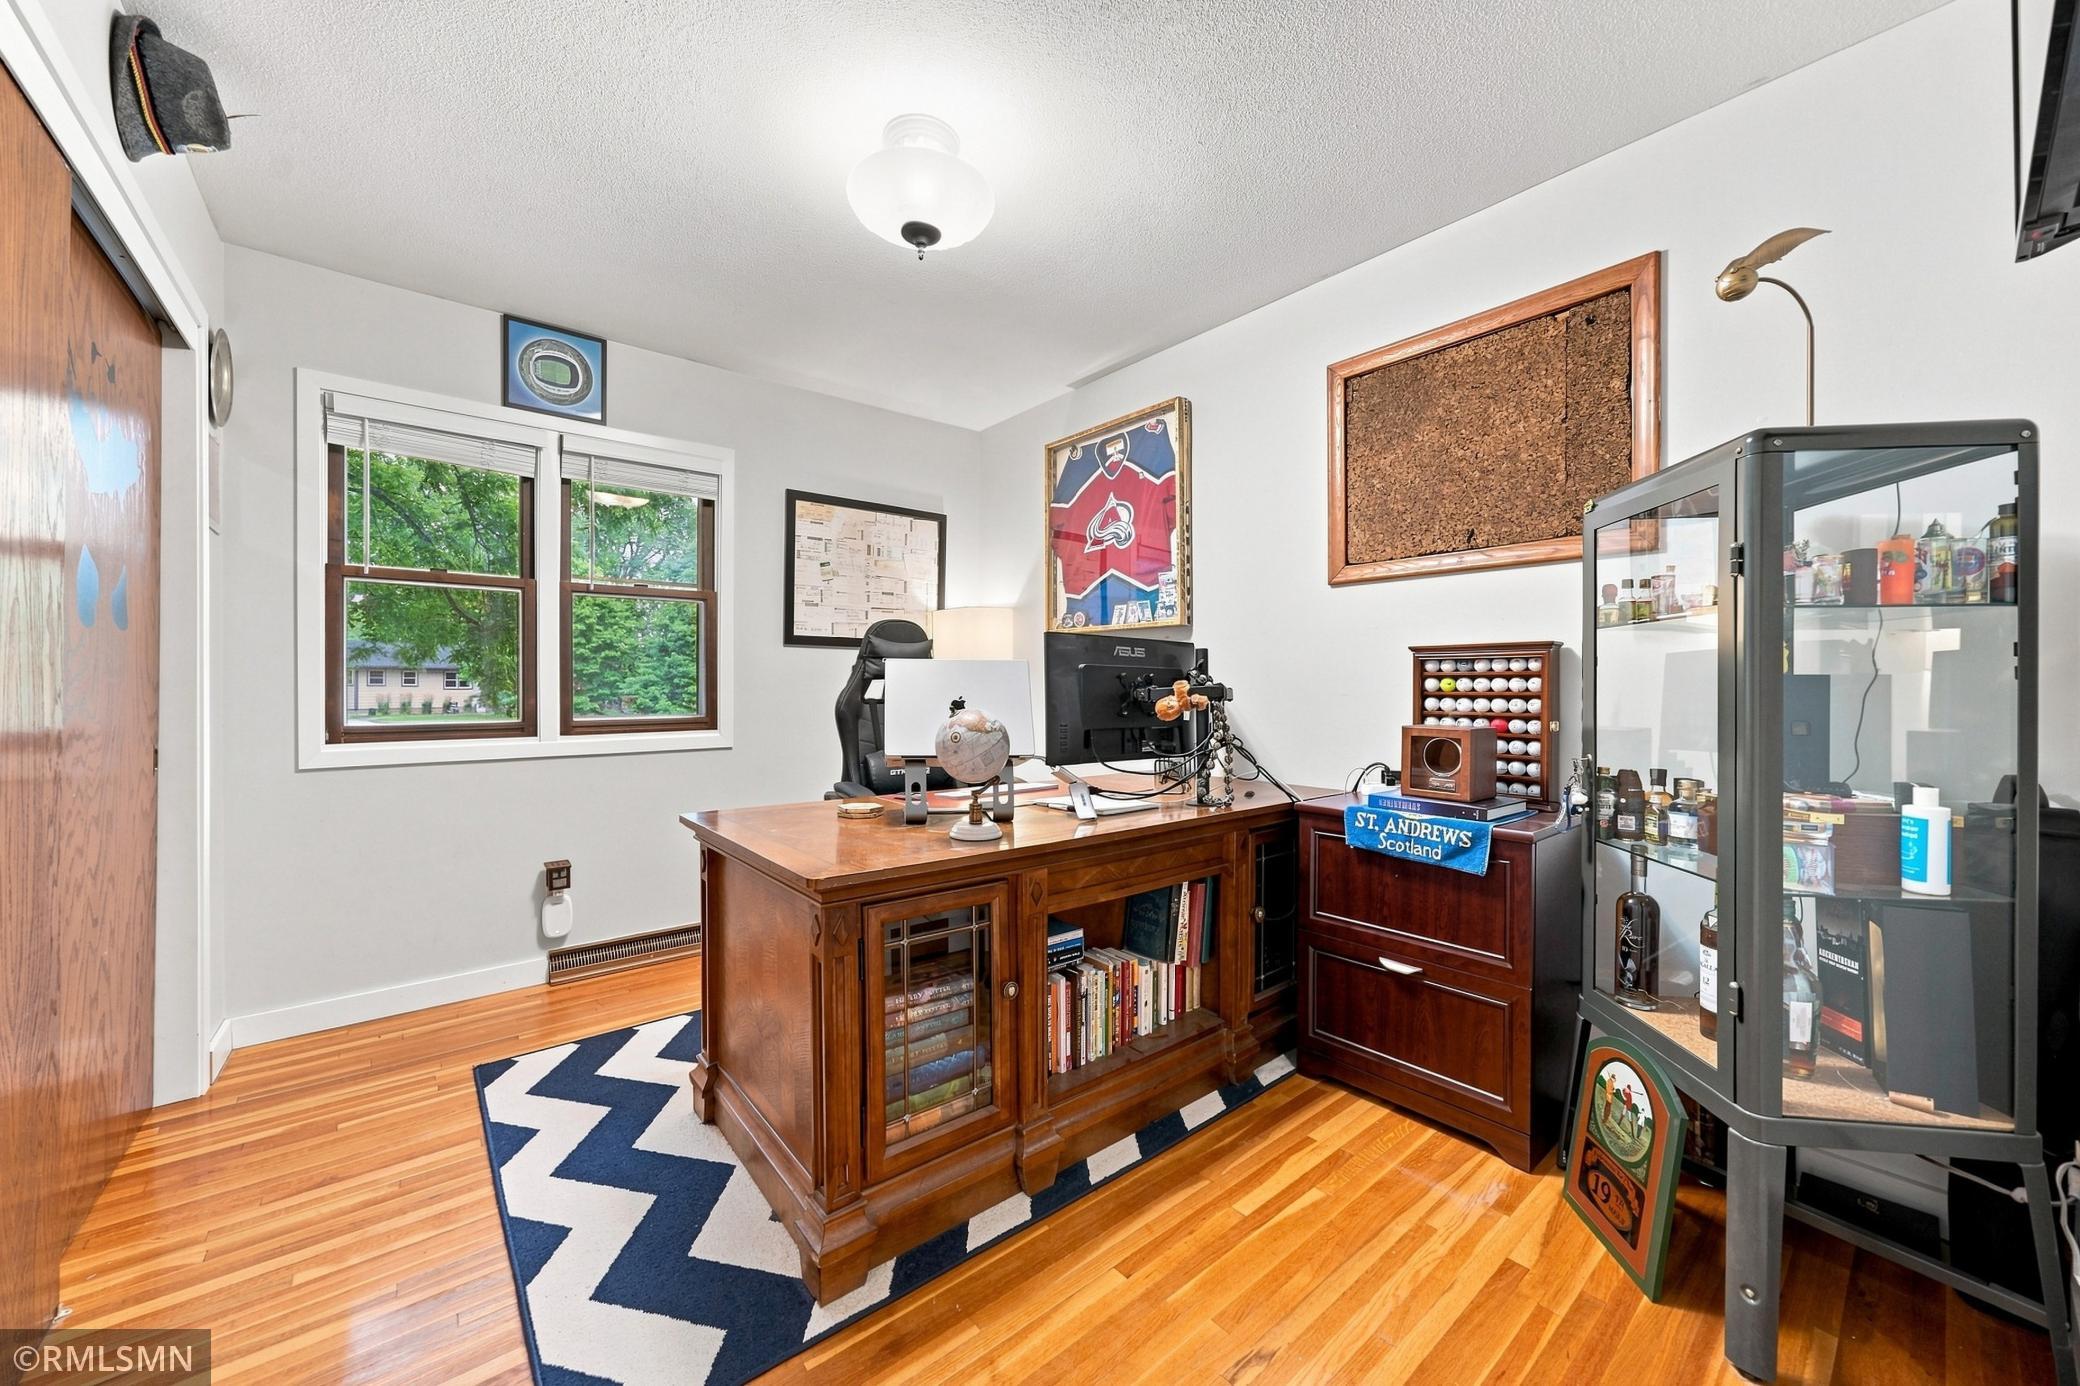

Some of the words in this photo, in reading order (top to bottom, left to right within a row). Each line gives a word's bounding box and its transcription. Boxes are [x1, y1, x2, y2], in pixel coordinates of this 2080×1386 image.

[1113, 646, 1145, 657] ASUS
[1355, 811, 1379, 832] ST.
[1384, 817, 1472, 848] ANDREWS
[1378, 832, 1442, 860] Scotland
[1590, 1173, 1612, 1204] 19
